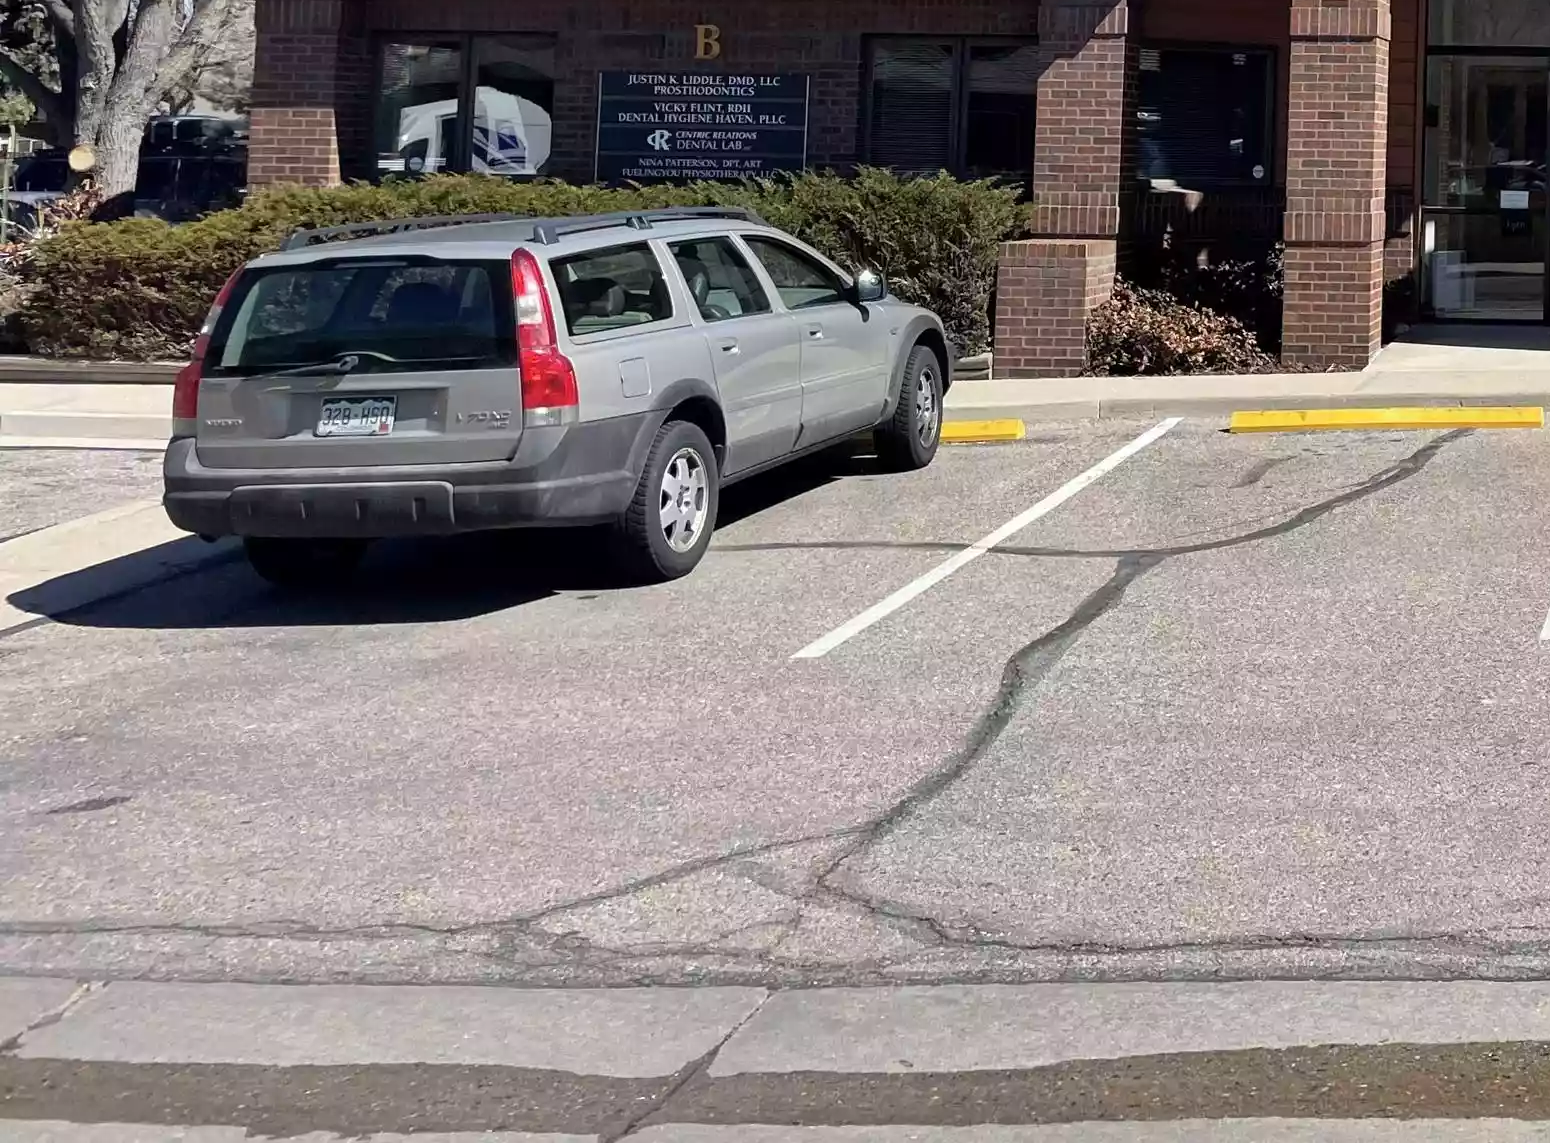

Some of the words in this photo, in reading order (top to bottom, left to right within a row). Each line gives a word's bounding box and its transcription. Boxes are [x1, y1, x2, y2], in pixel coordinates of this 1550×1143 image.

[694, 24, 720, 59] B
[627, 74, 666, 86] JUSTIN
[728, 76, 757, 87] DMD,
[760, 76, 781, 86] LLC
[654, 85, 755, 96] PROSTHODONTICS
[653, 102, 686, 112] VICKY
[690, 103, 725, 113] FLINT,
[618, 112, 662, 123] DENTAL
[664, 113, 713, 123] HYGIENE
[715, 114, 756, 125] HAVEN,
[759, 114, 787, 125] PLLC
[675, 130, 711, 139] CENTRIC
[713, 131, 758, 140] RELATIONS
[676, 139, 718, 150] DENTAL
[722, 140, 742, 150] LAB
[639, 157, 663, 167] NINA
[743, 159, 763, 168] ART
